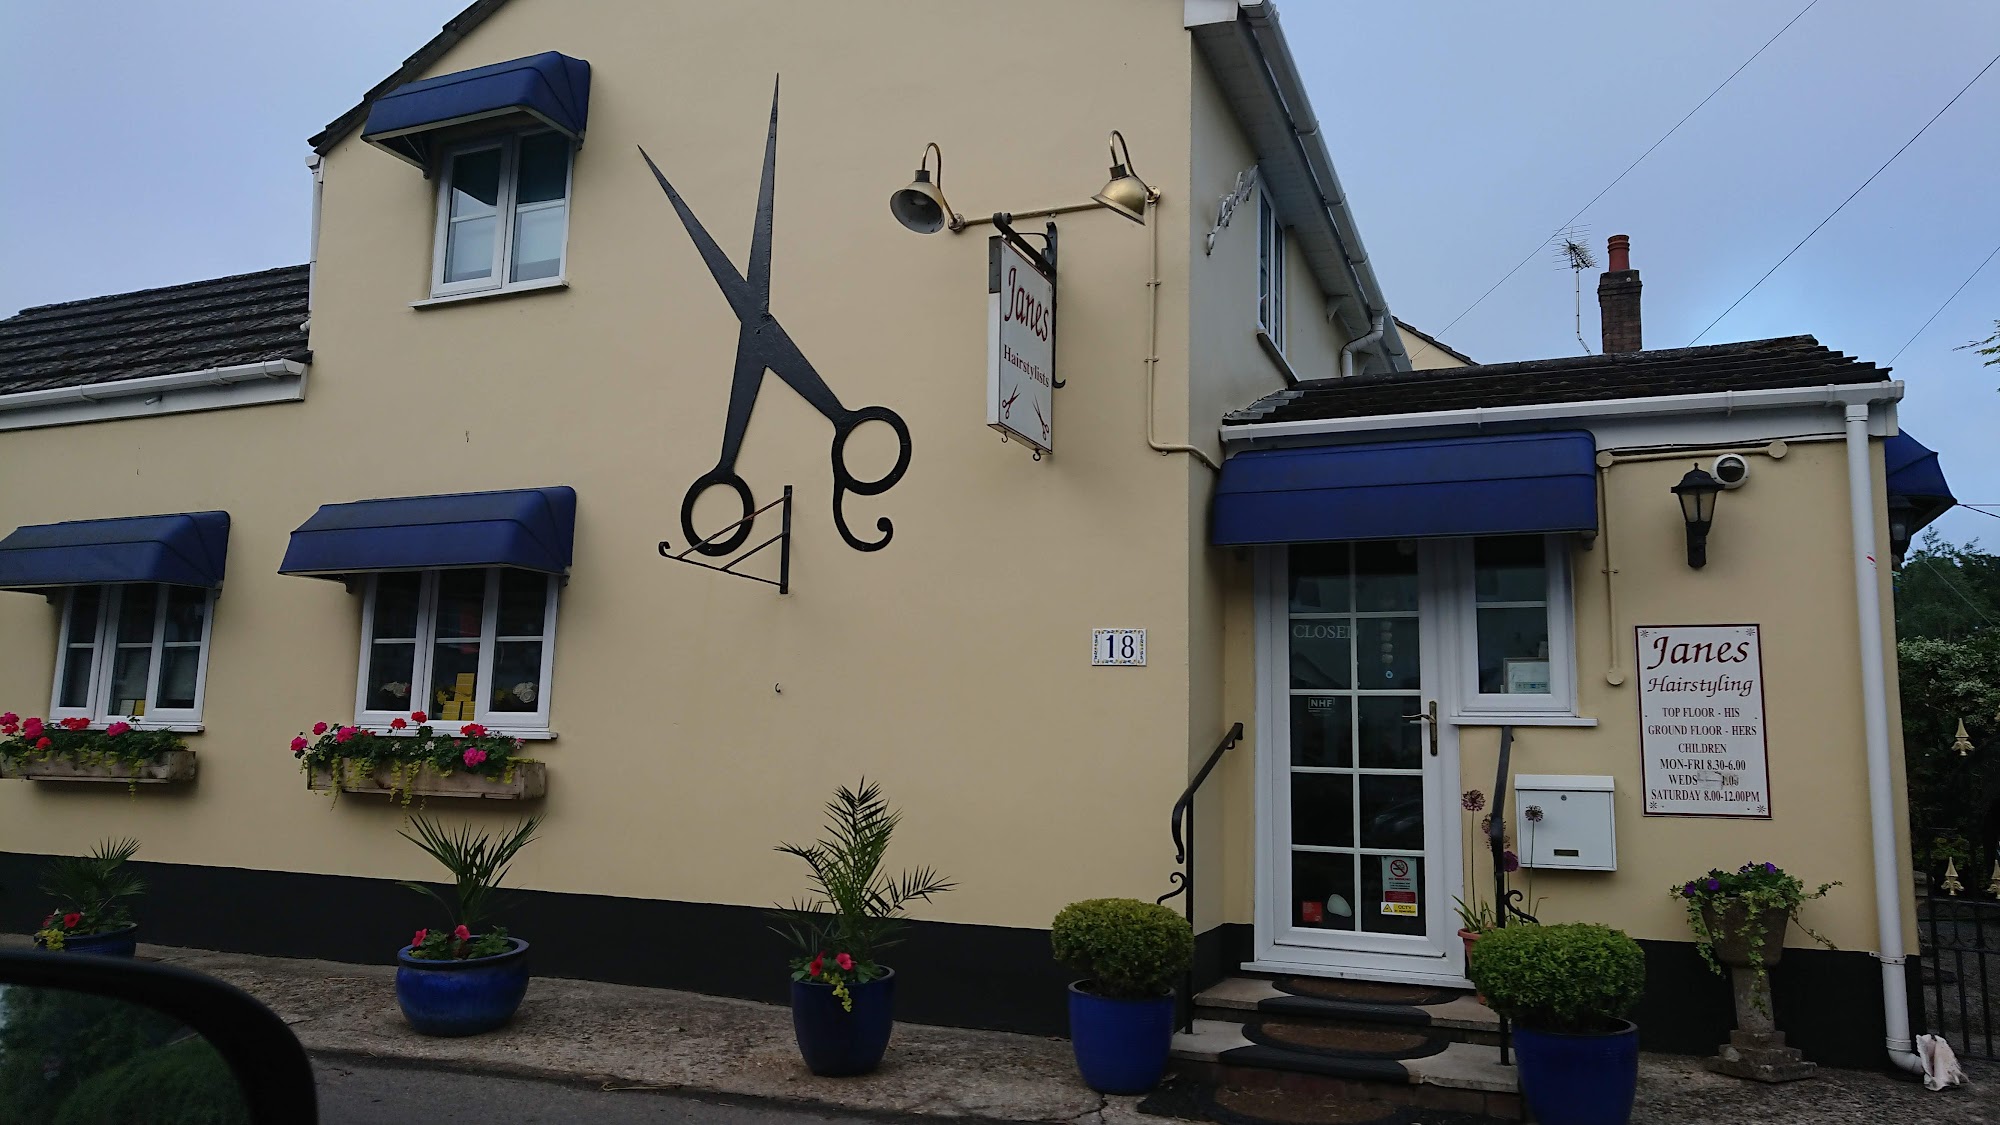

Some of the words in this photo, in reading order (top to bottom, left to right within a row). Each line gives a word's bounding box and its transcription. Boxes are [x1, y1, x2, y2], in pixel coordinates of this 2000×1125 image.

[1004, 265, 1049, 342] Janes
[1003, 343, 1049, 388] Hairstylists
[1105, 634, 1135, 659] 18
[1646, 635, 1750, 670] Janes
[1647, 673, 1754, 698] Hairstyling
[1310, 698, 1333, 708] NHF
[1662, 707, 1681, 718] TOP
[1683, 707, 1715, 718] FLOOR
[1724, 707, 1740, 718] HIS
[1648, 724, 1687, 736] GROUND
[1690, 724, 1723, 736] FLOOR
[1732, 725, 1757, 736] HERS
[1678, 743, 1727, 754] CHILDREN
[1660, 758, 1704, 770] MON-FRI
[1707, 759, 1746, 771] 8.30-6.00
[1668, 774, 1698, 786] WEDS
[1651, 789, 1701, 801] SATURDAY
[1703, 790, 1760, 803] 8.00-12.00PM
